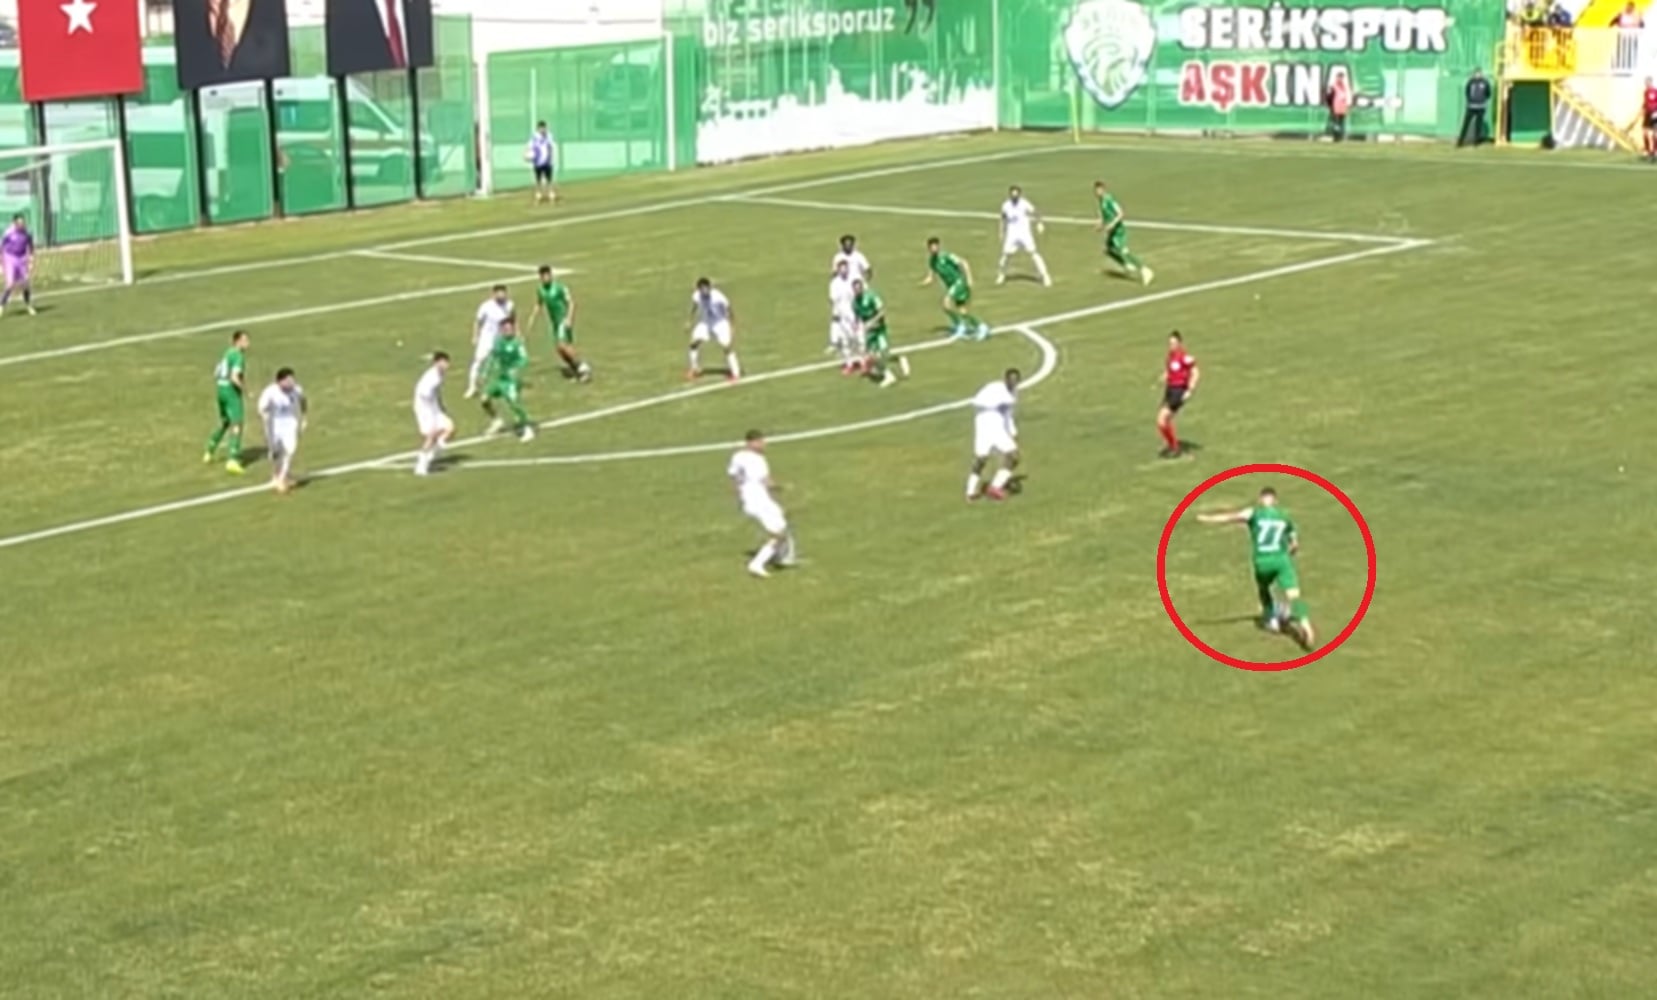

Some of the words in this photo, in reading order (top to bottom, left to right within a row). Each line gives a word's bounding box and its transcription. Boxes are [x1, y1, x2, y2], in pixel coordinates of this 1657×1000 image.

[703, 15, 740, 48] biz
[1180, 2, 1447, 51] SERİKSPOR
[1257, 519, 1287, 548] 77
